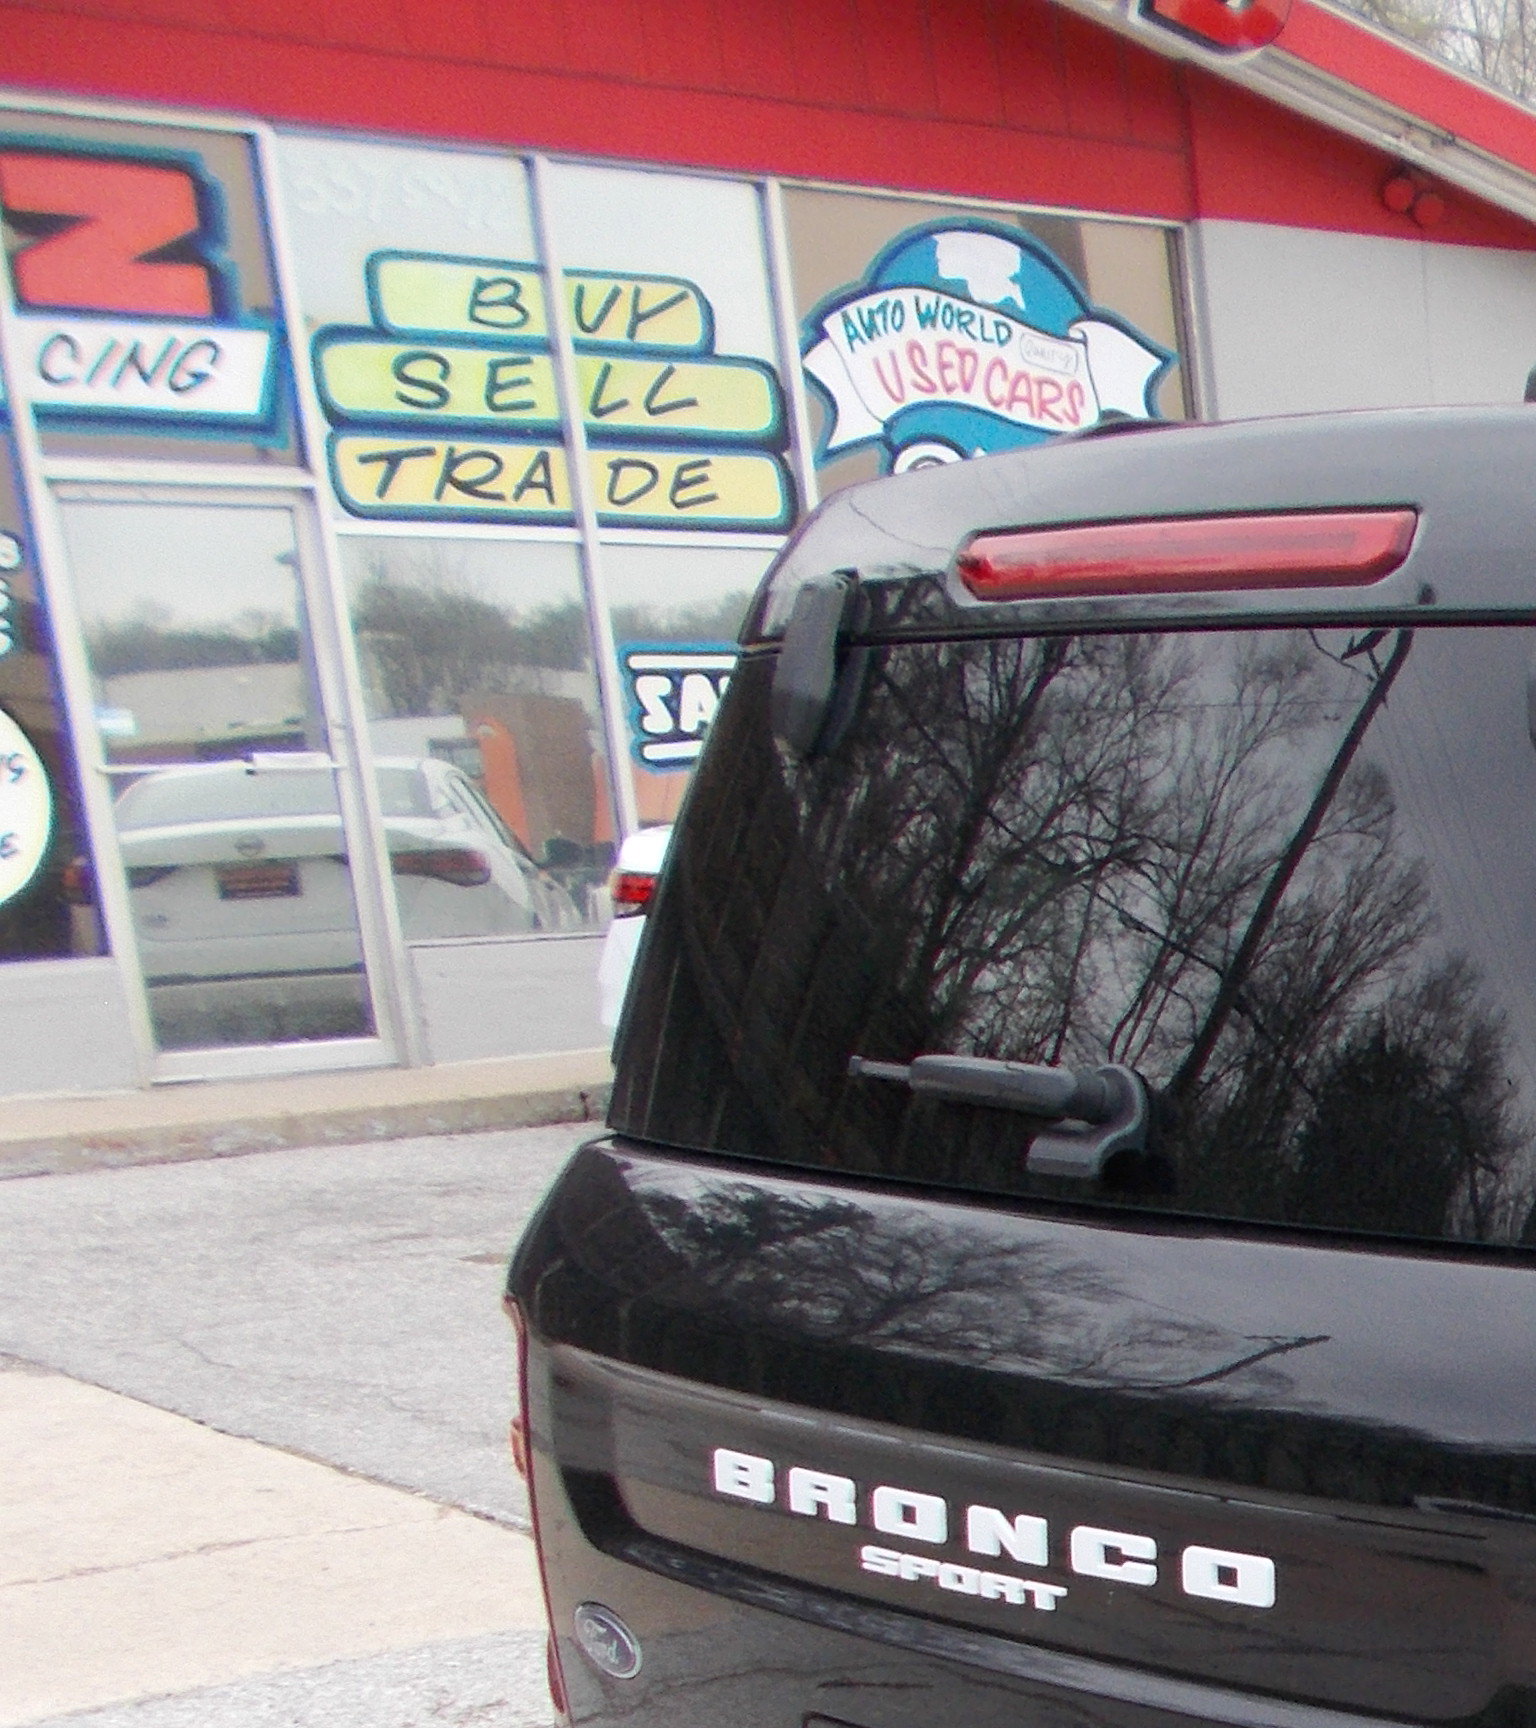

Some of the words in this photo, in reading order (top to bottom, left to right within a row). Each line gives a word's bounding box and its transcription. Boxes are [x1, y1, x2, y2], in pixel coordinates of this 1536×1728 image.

[468, 275, 691, 342] BUY
[841, 299, 905, 353] AUTO
[914, 295, 1013, 348] WORLD
[37, 332, 223, 393] CING
[392, 350, 699, 419] SELL
[873, 339, 979, 405] USED
[983, 356, 1086, 427] CARS
[356, 444, 719, 511] TRADE
[635, 673, 731, 734] SA
[712, 1447, 1277, 1609] BRONCO
[860, 1545, 1068, 1612] SPORT
